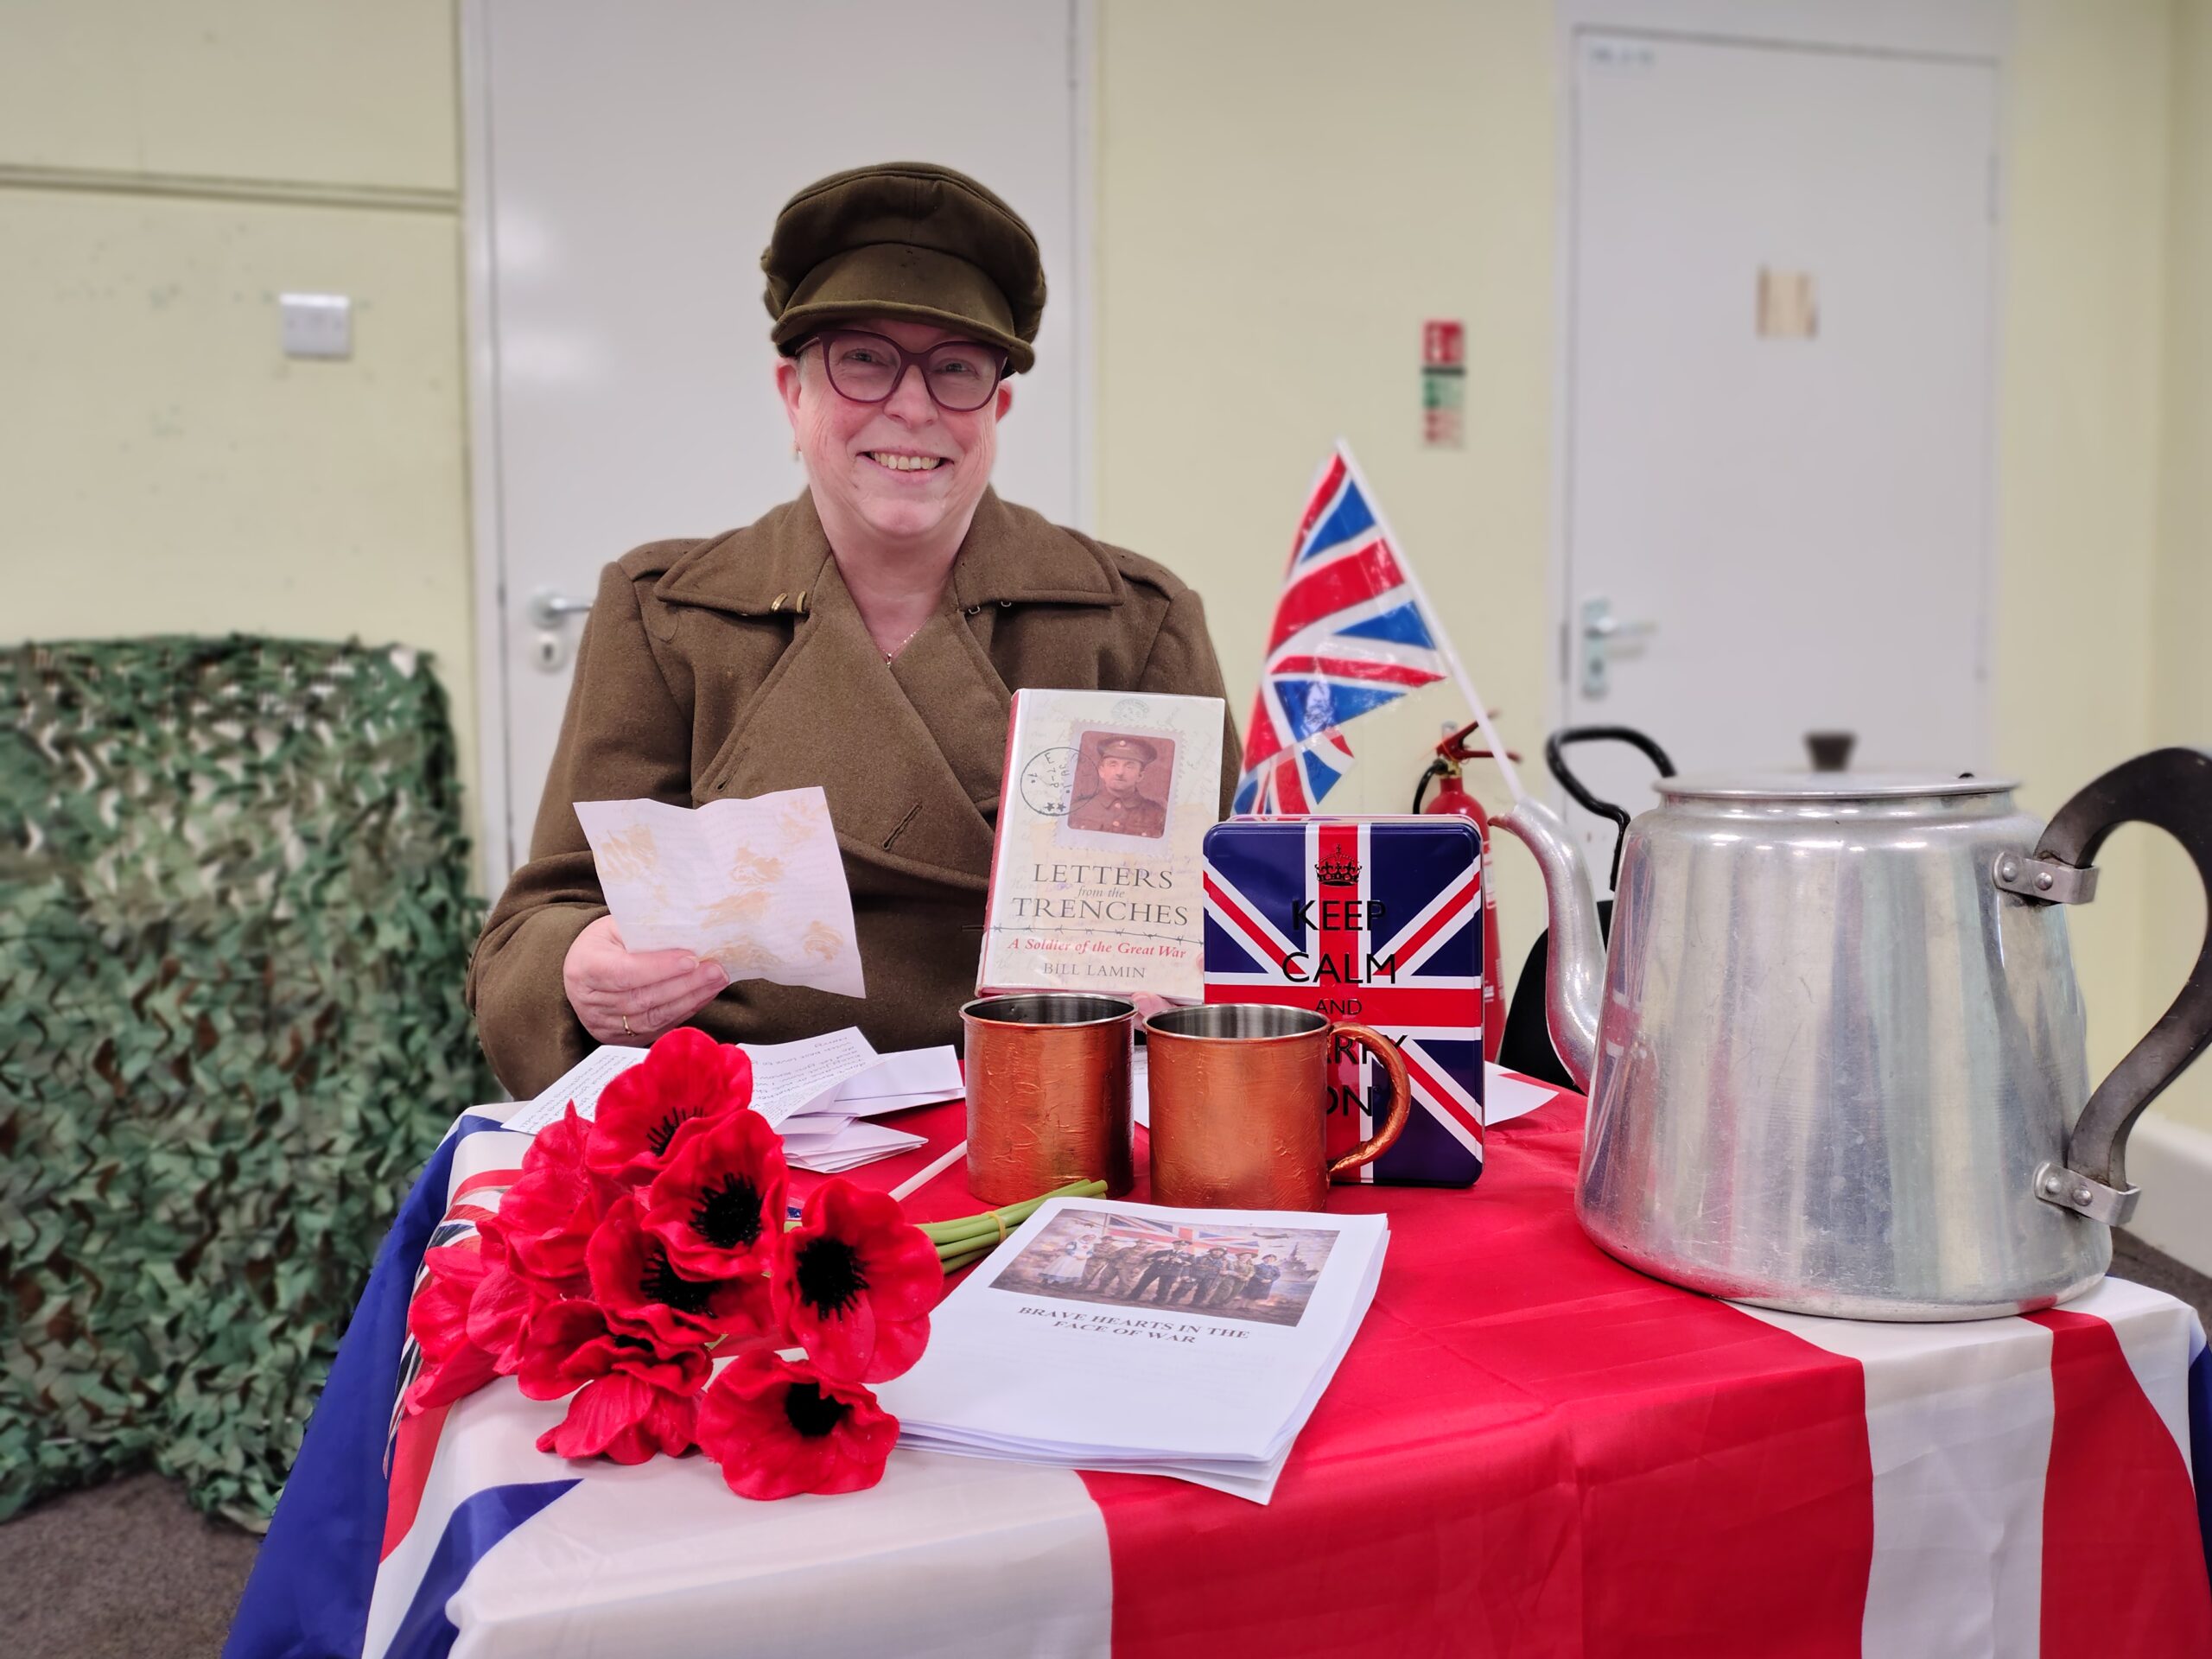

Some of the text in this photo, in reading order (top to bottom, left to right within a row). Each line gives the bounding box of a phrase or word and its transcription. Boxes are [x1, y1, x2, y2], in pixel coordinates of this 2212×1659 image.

[1032, 864, 1173, 890] LETTERS
[1075, 887, 1125, 899] from the
[1012, 897, 1188, 926] TRENCHES
[1291, 899, 1386, 931] KEEP
[1007, 938, 1187, 959] A Soldier of the Great War
[1044, 962, 1146, 979] BILL LAMIN
[1282, 952, 1396, 984] CALM
[1314, 999, 1363, 1016] AND
[1019, 1306, 1250, 1339] BRAVE HEARTS IN THE
[1052, 1321, 1196, 1344] FACE OF WAR
